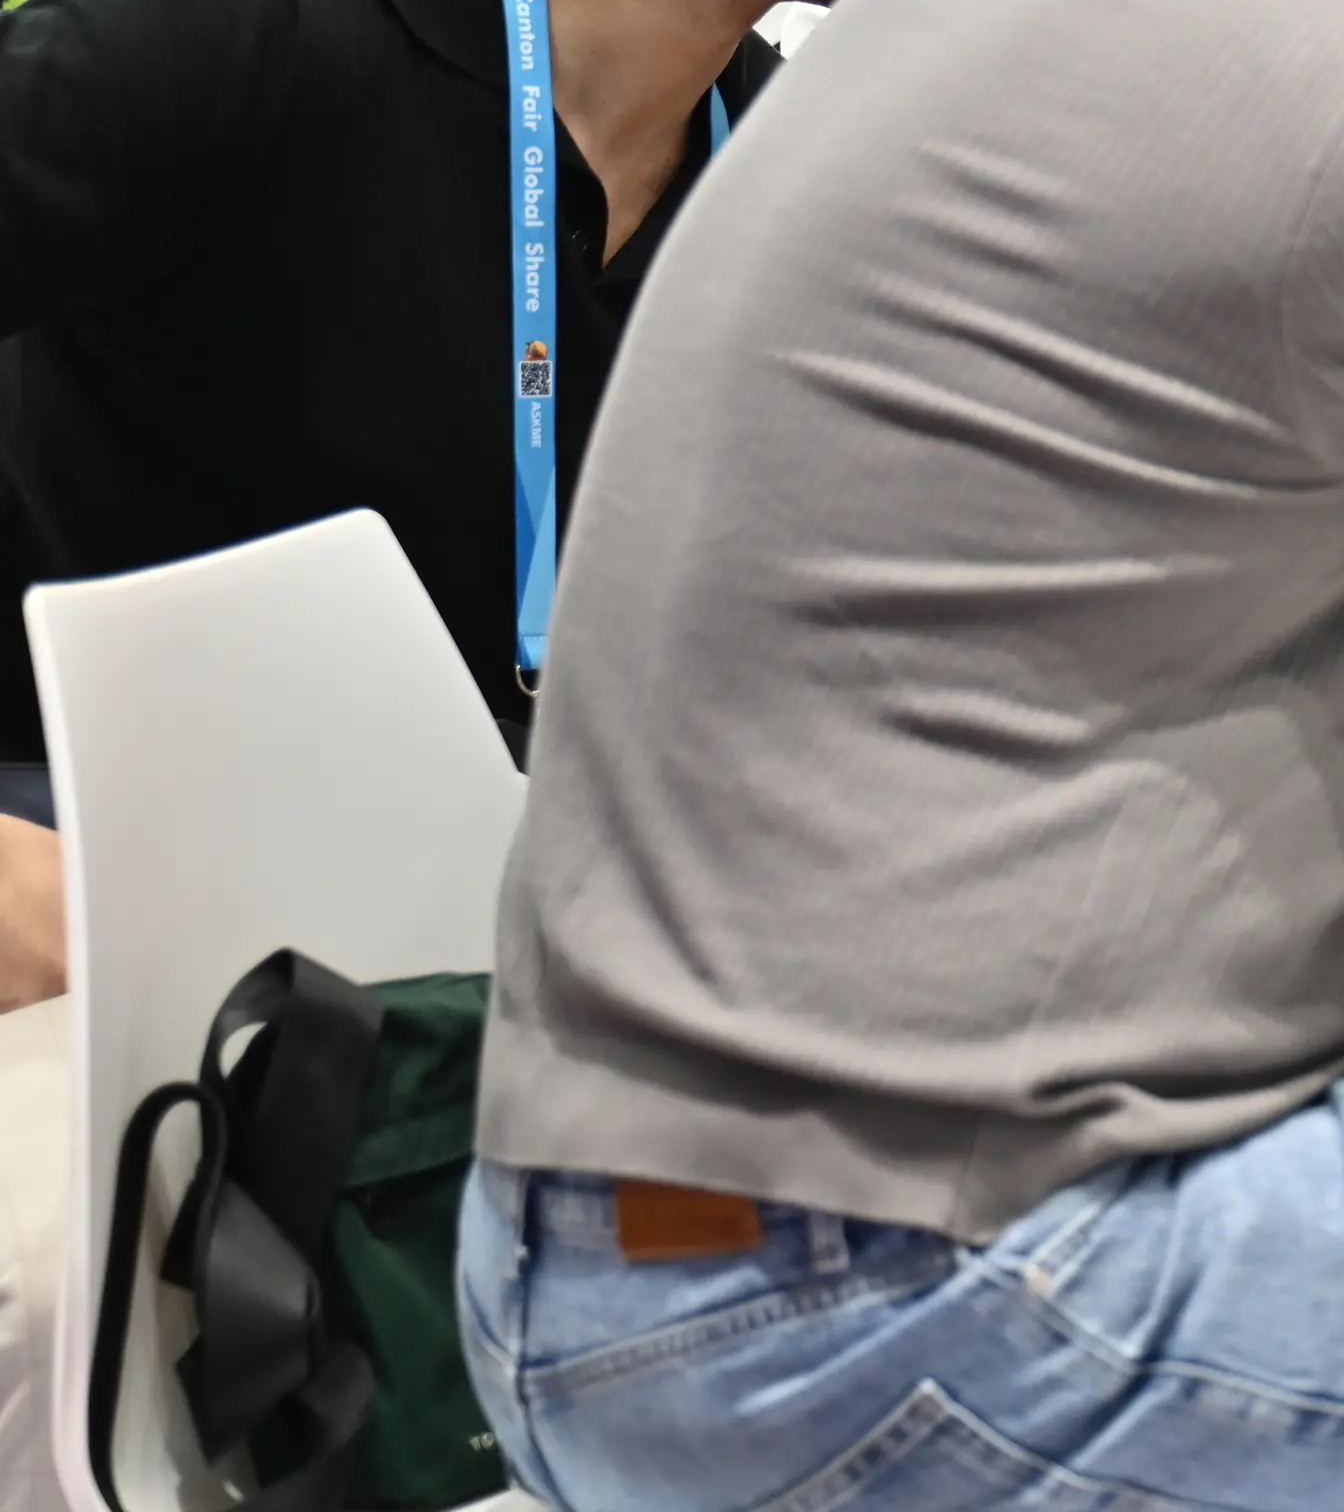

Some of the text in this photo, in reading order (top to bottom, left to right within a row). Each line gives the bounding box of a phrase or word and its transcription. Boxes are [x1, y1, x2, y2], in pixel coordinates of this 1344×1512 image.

[521, 84, 543, 132] Fair
[523, 146, 545, 227] Global
[524, 242, 545, 312] Share
